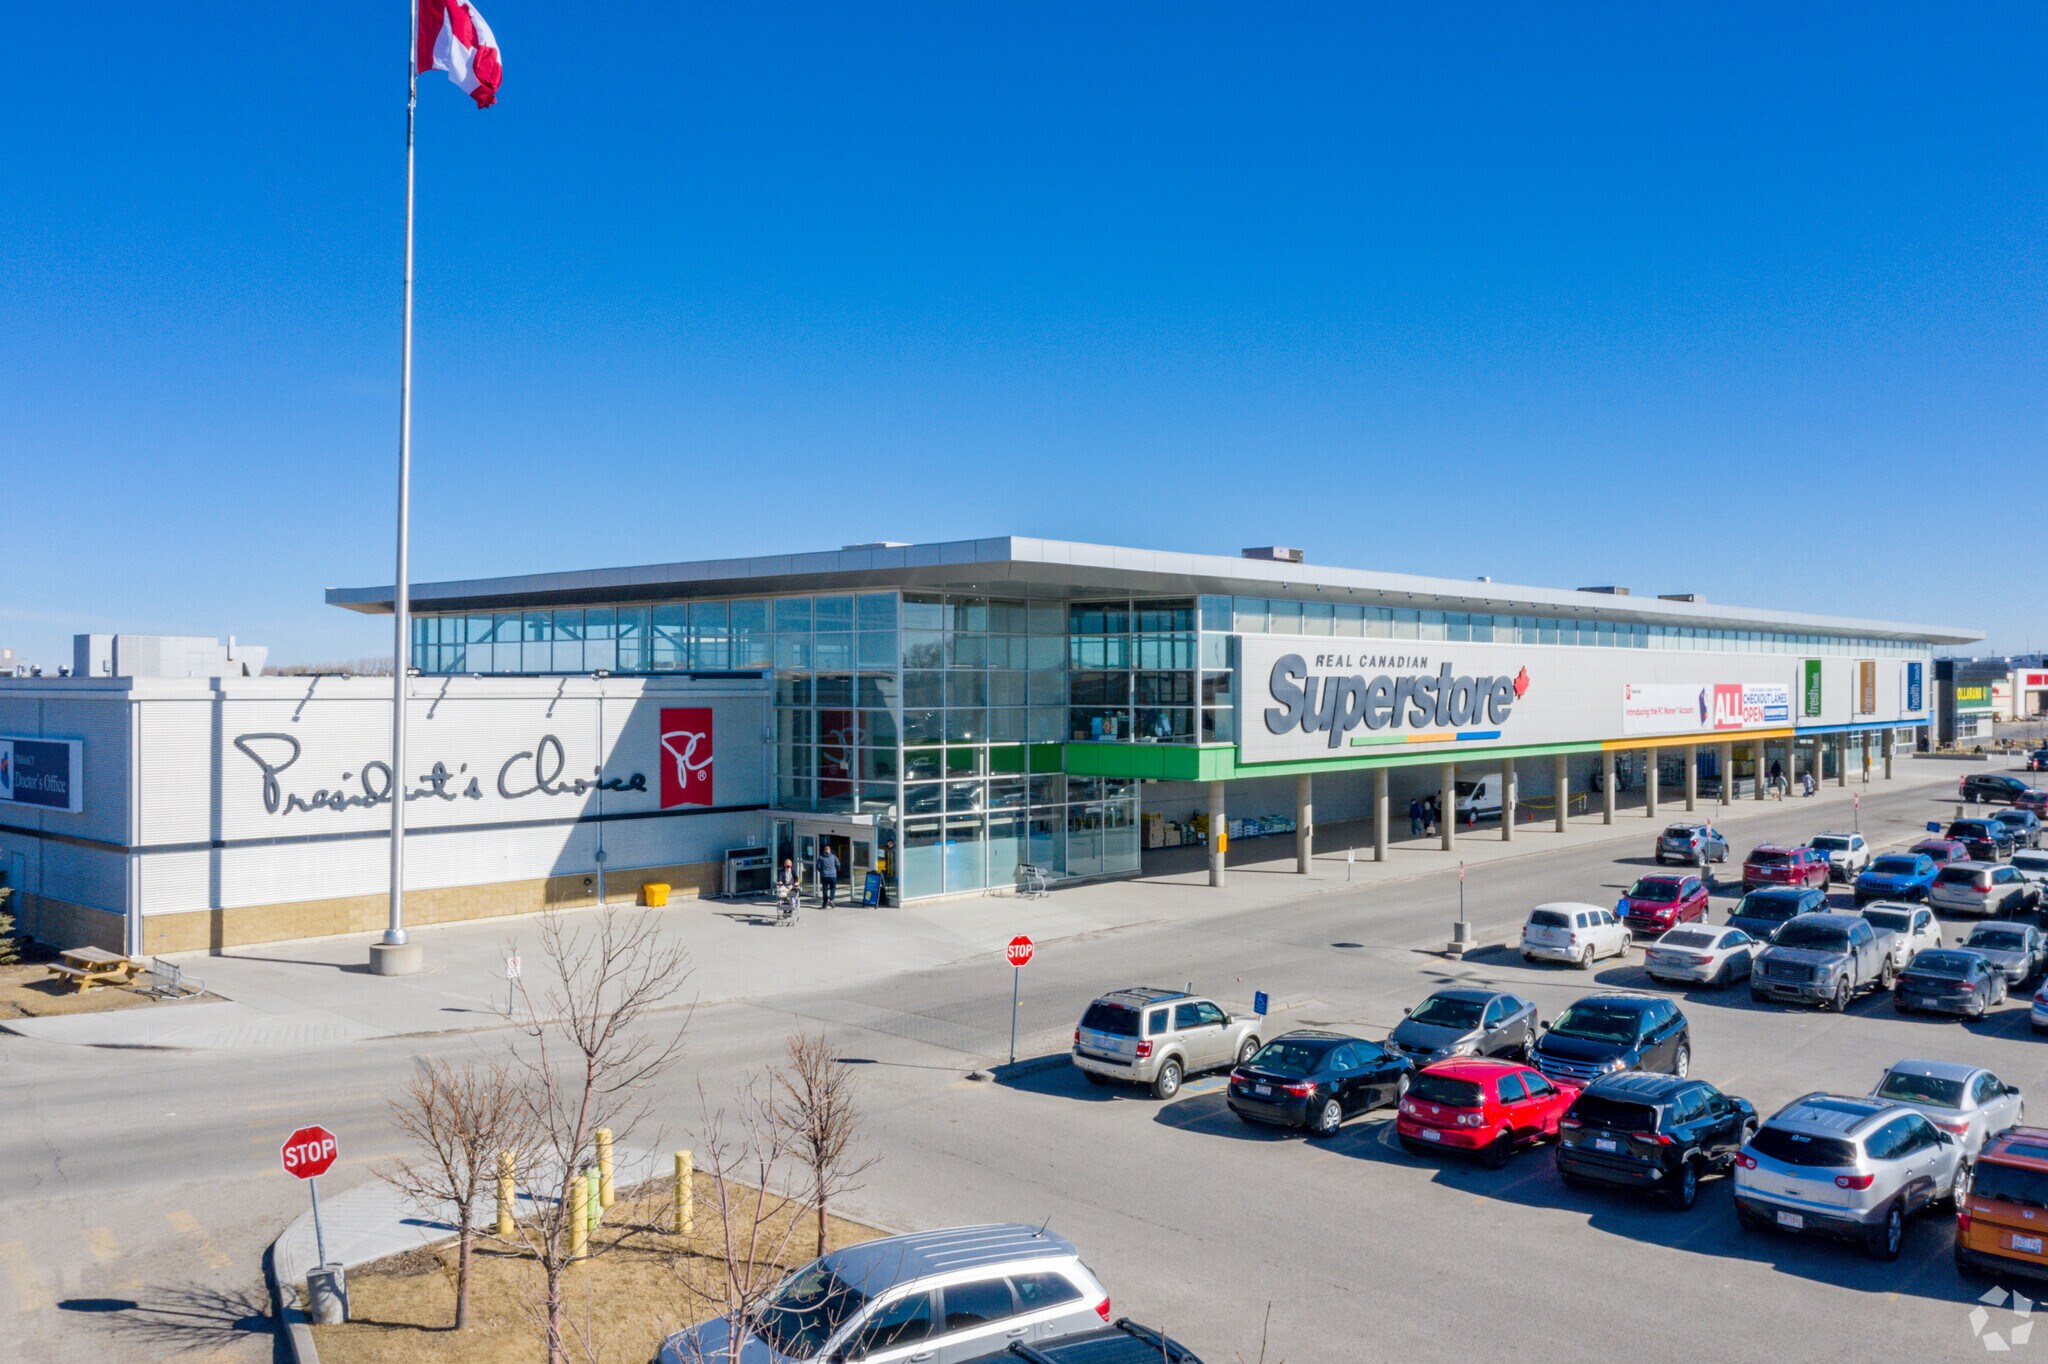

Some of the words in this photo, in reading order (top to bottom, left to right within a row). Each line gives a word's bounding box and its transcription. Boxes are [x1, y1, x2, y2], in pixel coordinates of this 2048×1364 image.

[1315, 654, 1352, 668] REAL
[1359, 654, 1428, 669] CANADIAN
[1264, 653, 1515, 749] Superstore
[1714, 692, 1742, 725] ALL
[1743, 694, 1771, 705] CHECKOUT
[1771, 693, 1787, 703] LANES
[1807, 689, 1819, 715] fresh
[1909, 684, 1920, 709] health
[1743, 706, 1763, 722] OPEN
[15, 771, 43, 790] Doctor's
[44, 774, 66, 792] Office
[234, 733, 482, 815] Presidnt's
[498, 734, 647, 799] Choice
[1008, 944, 1032, 957] STOP
[285, 1138, 334, 1167] STOP
